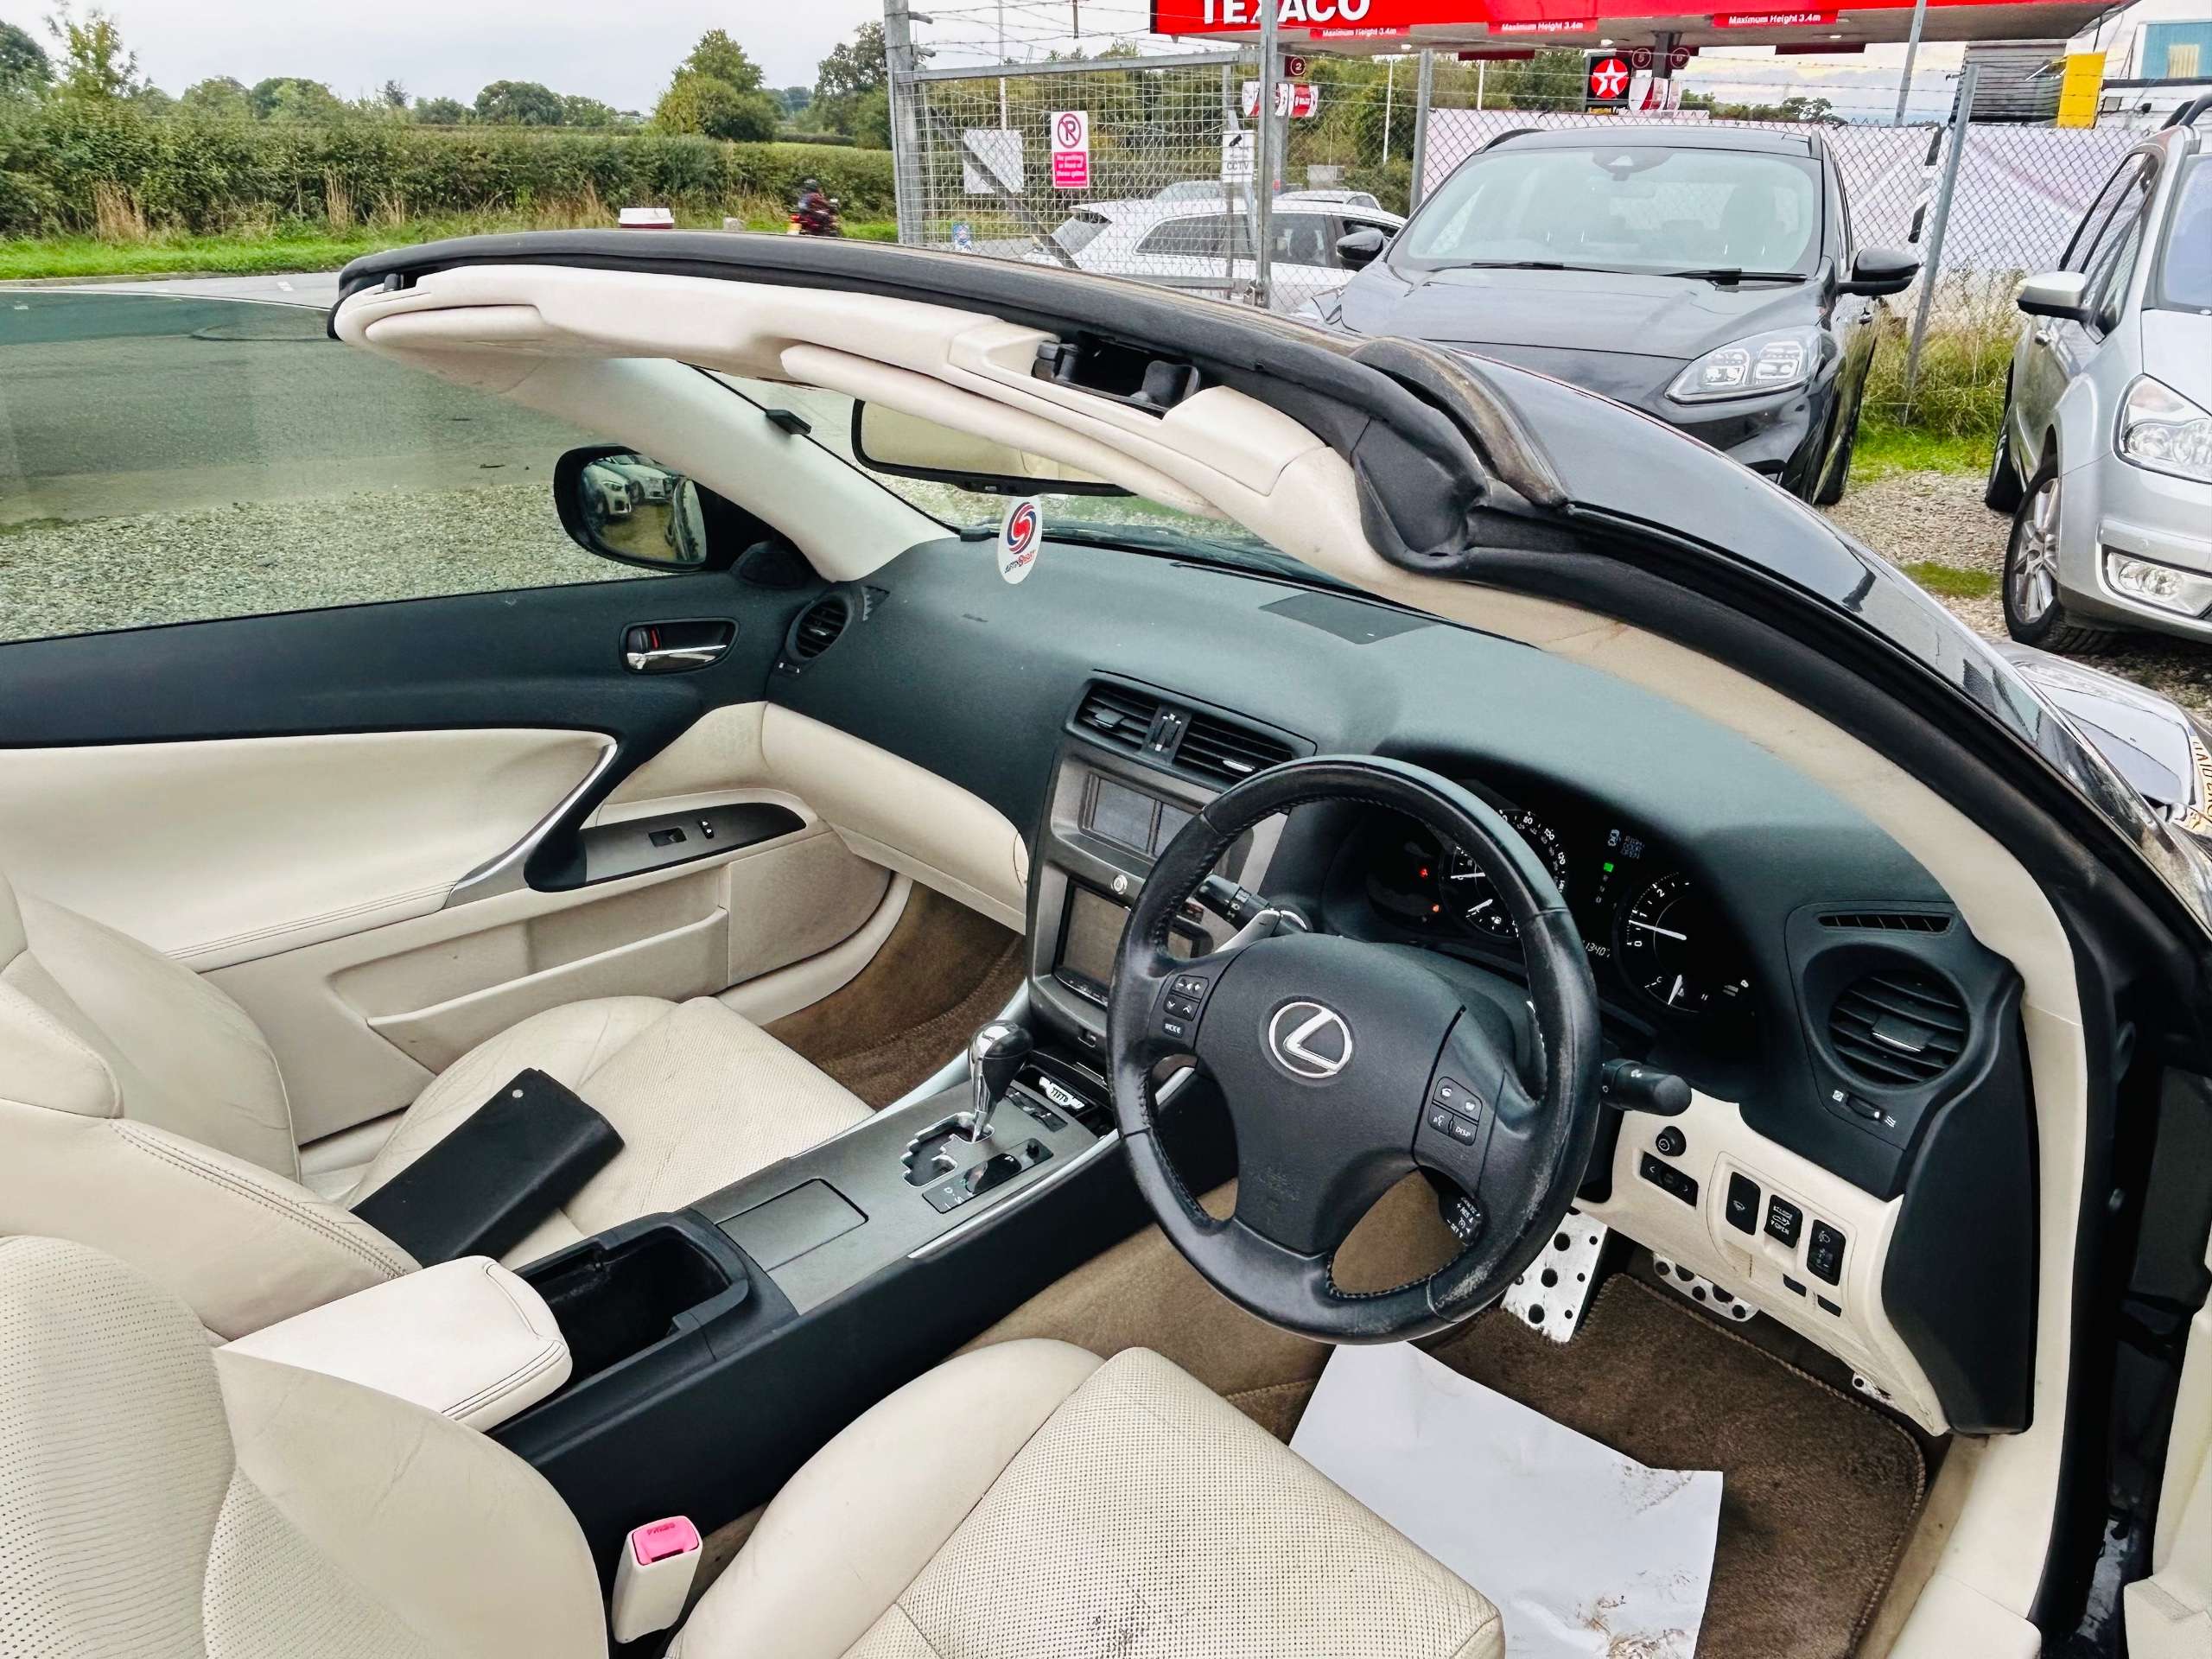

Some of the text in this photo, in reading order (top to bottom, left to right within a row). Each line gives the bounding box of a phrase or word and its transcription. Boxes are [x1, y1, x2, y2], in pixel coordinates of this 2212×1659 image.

[1729, 14, 1821, 25] Maximum Height 3.4m
[1226, 161, 1249, 171] CCTV
[1656, 889, 1665, 898] 2
